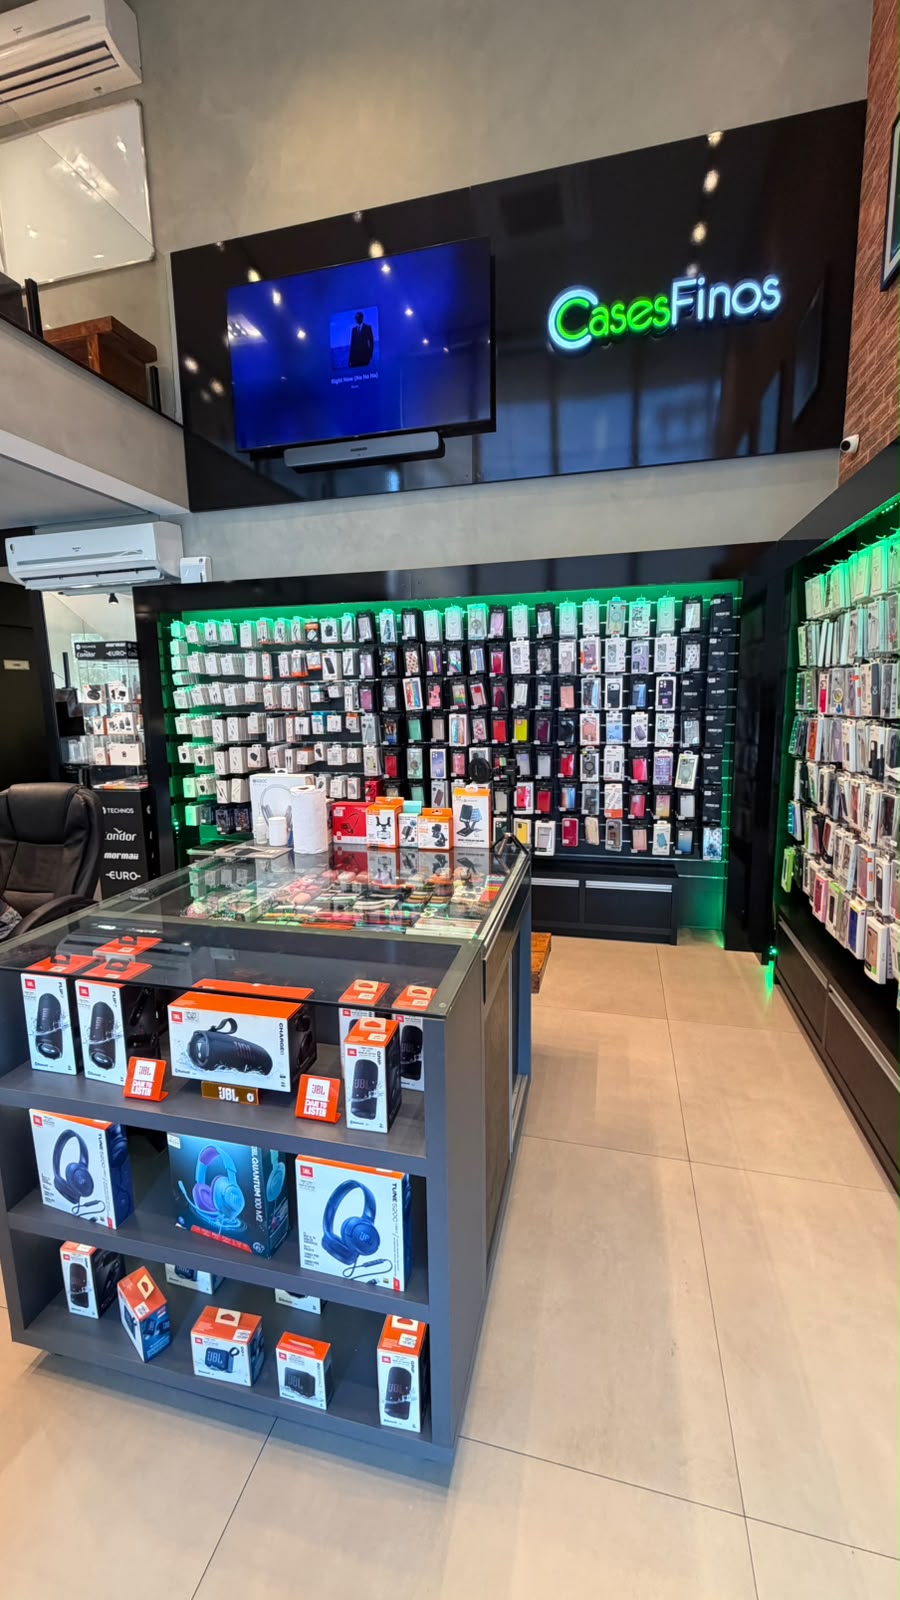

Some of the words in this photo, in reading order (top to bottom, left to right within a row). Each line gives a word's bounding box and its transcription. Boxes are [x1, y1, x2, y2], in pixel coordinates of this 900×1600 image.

[548, 274, 781, 350] CasesFinos
[218, 1086, 239, 1102] JBL
[312, 1084, 325, 1095] JBL
[252, 1157, 260, 1198] QUANTUM
[207, 1351, 223, 1364] JBL
